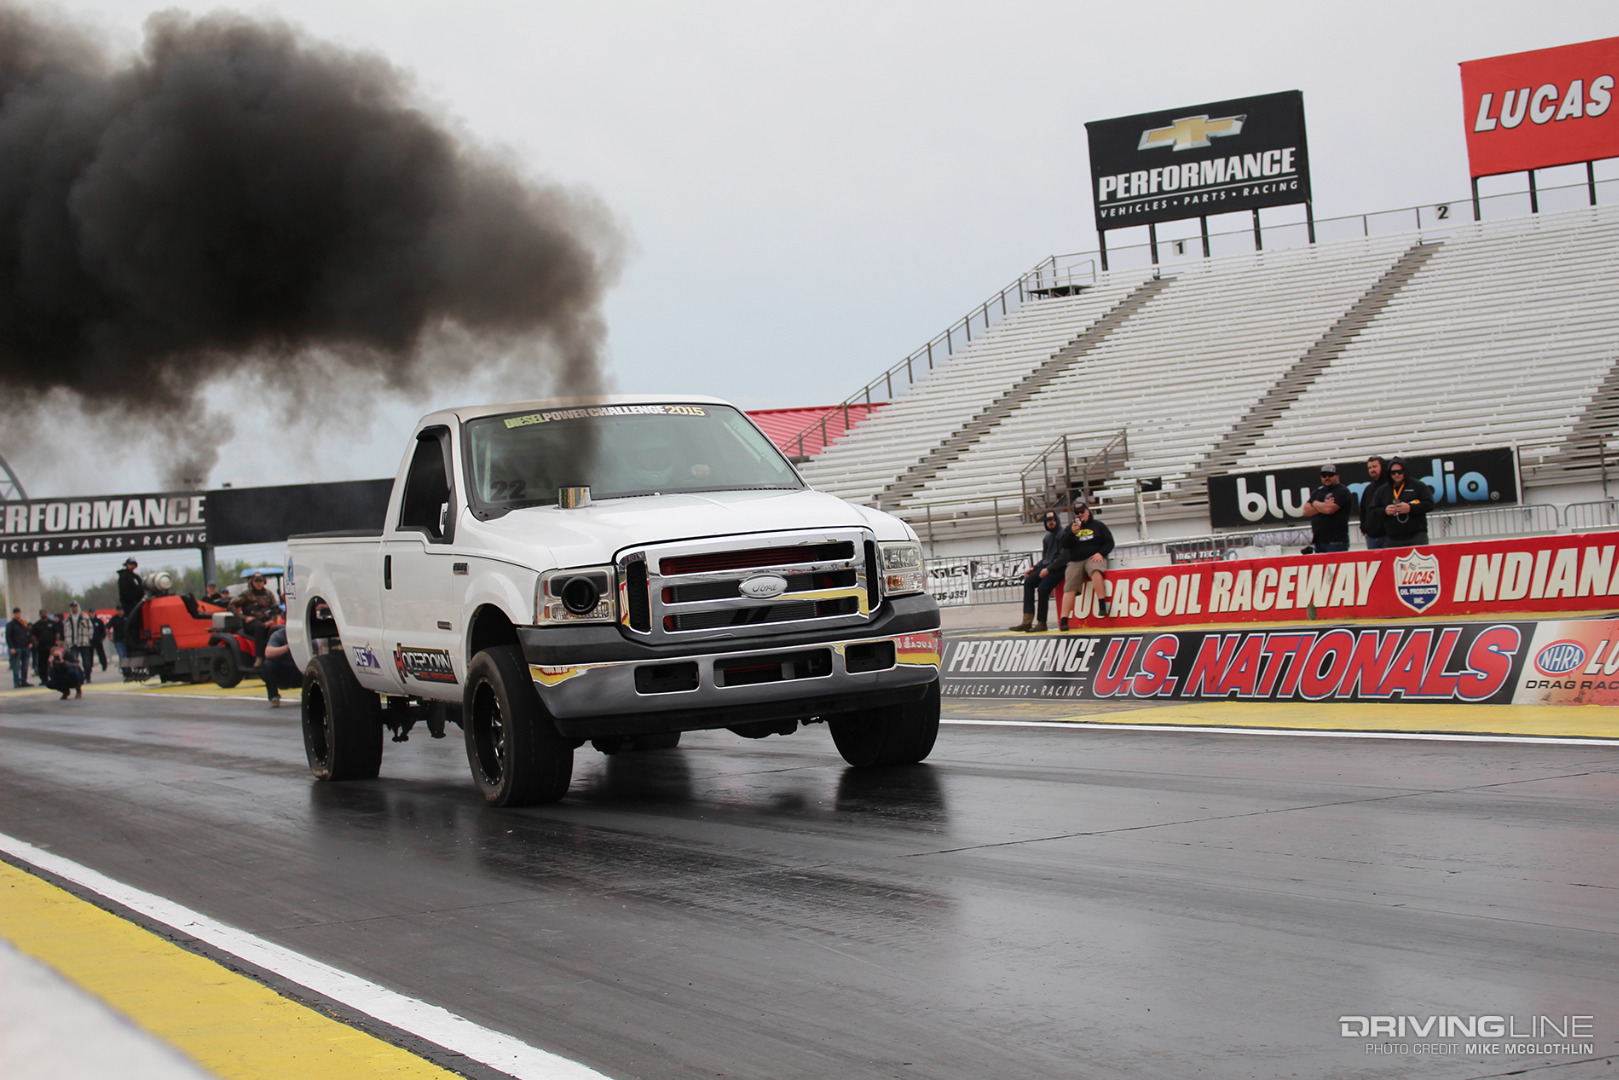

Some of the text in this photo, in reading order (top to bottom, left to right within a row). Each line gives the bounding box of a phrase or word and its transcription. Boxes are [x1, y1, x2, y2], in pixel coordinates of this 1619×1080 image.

[1473, 75, 1615, 133] LUCAS
[1099, 147, 1297, 202] PERFORMANCE
[1100, 181, 1299, 218] VEHICLES PARTS RACING
[1437, 205, 1449, 220] 2
[1175, 241, 1184, 254] 1
[664, 405, 706, 416] 2015
[490, 479, 526, 499] 22
[71, 537, 123, 550] PARTS
[143, 532, 208, 546] RACING
[1402, 570, 1435, 585] LUCAS
[1069, 561, 1382, 619] UCAS OIL RACEWAY
[947, 638, 1100, 673] PERFORMANCE
[1092, 624, 1522, 702] U.S. NATIONALS
[1540, 645, 1581, 671] NHRA
[941, 684, 1084, 697] VEHICLES PARTS RACING
[1525, 680, 1577, 689] DRAG
